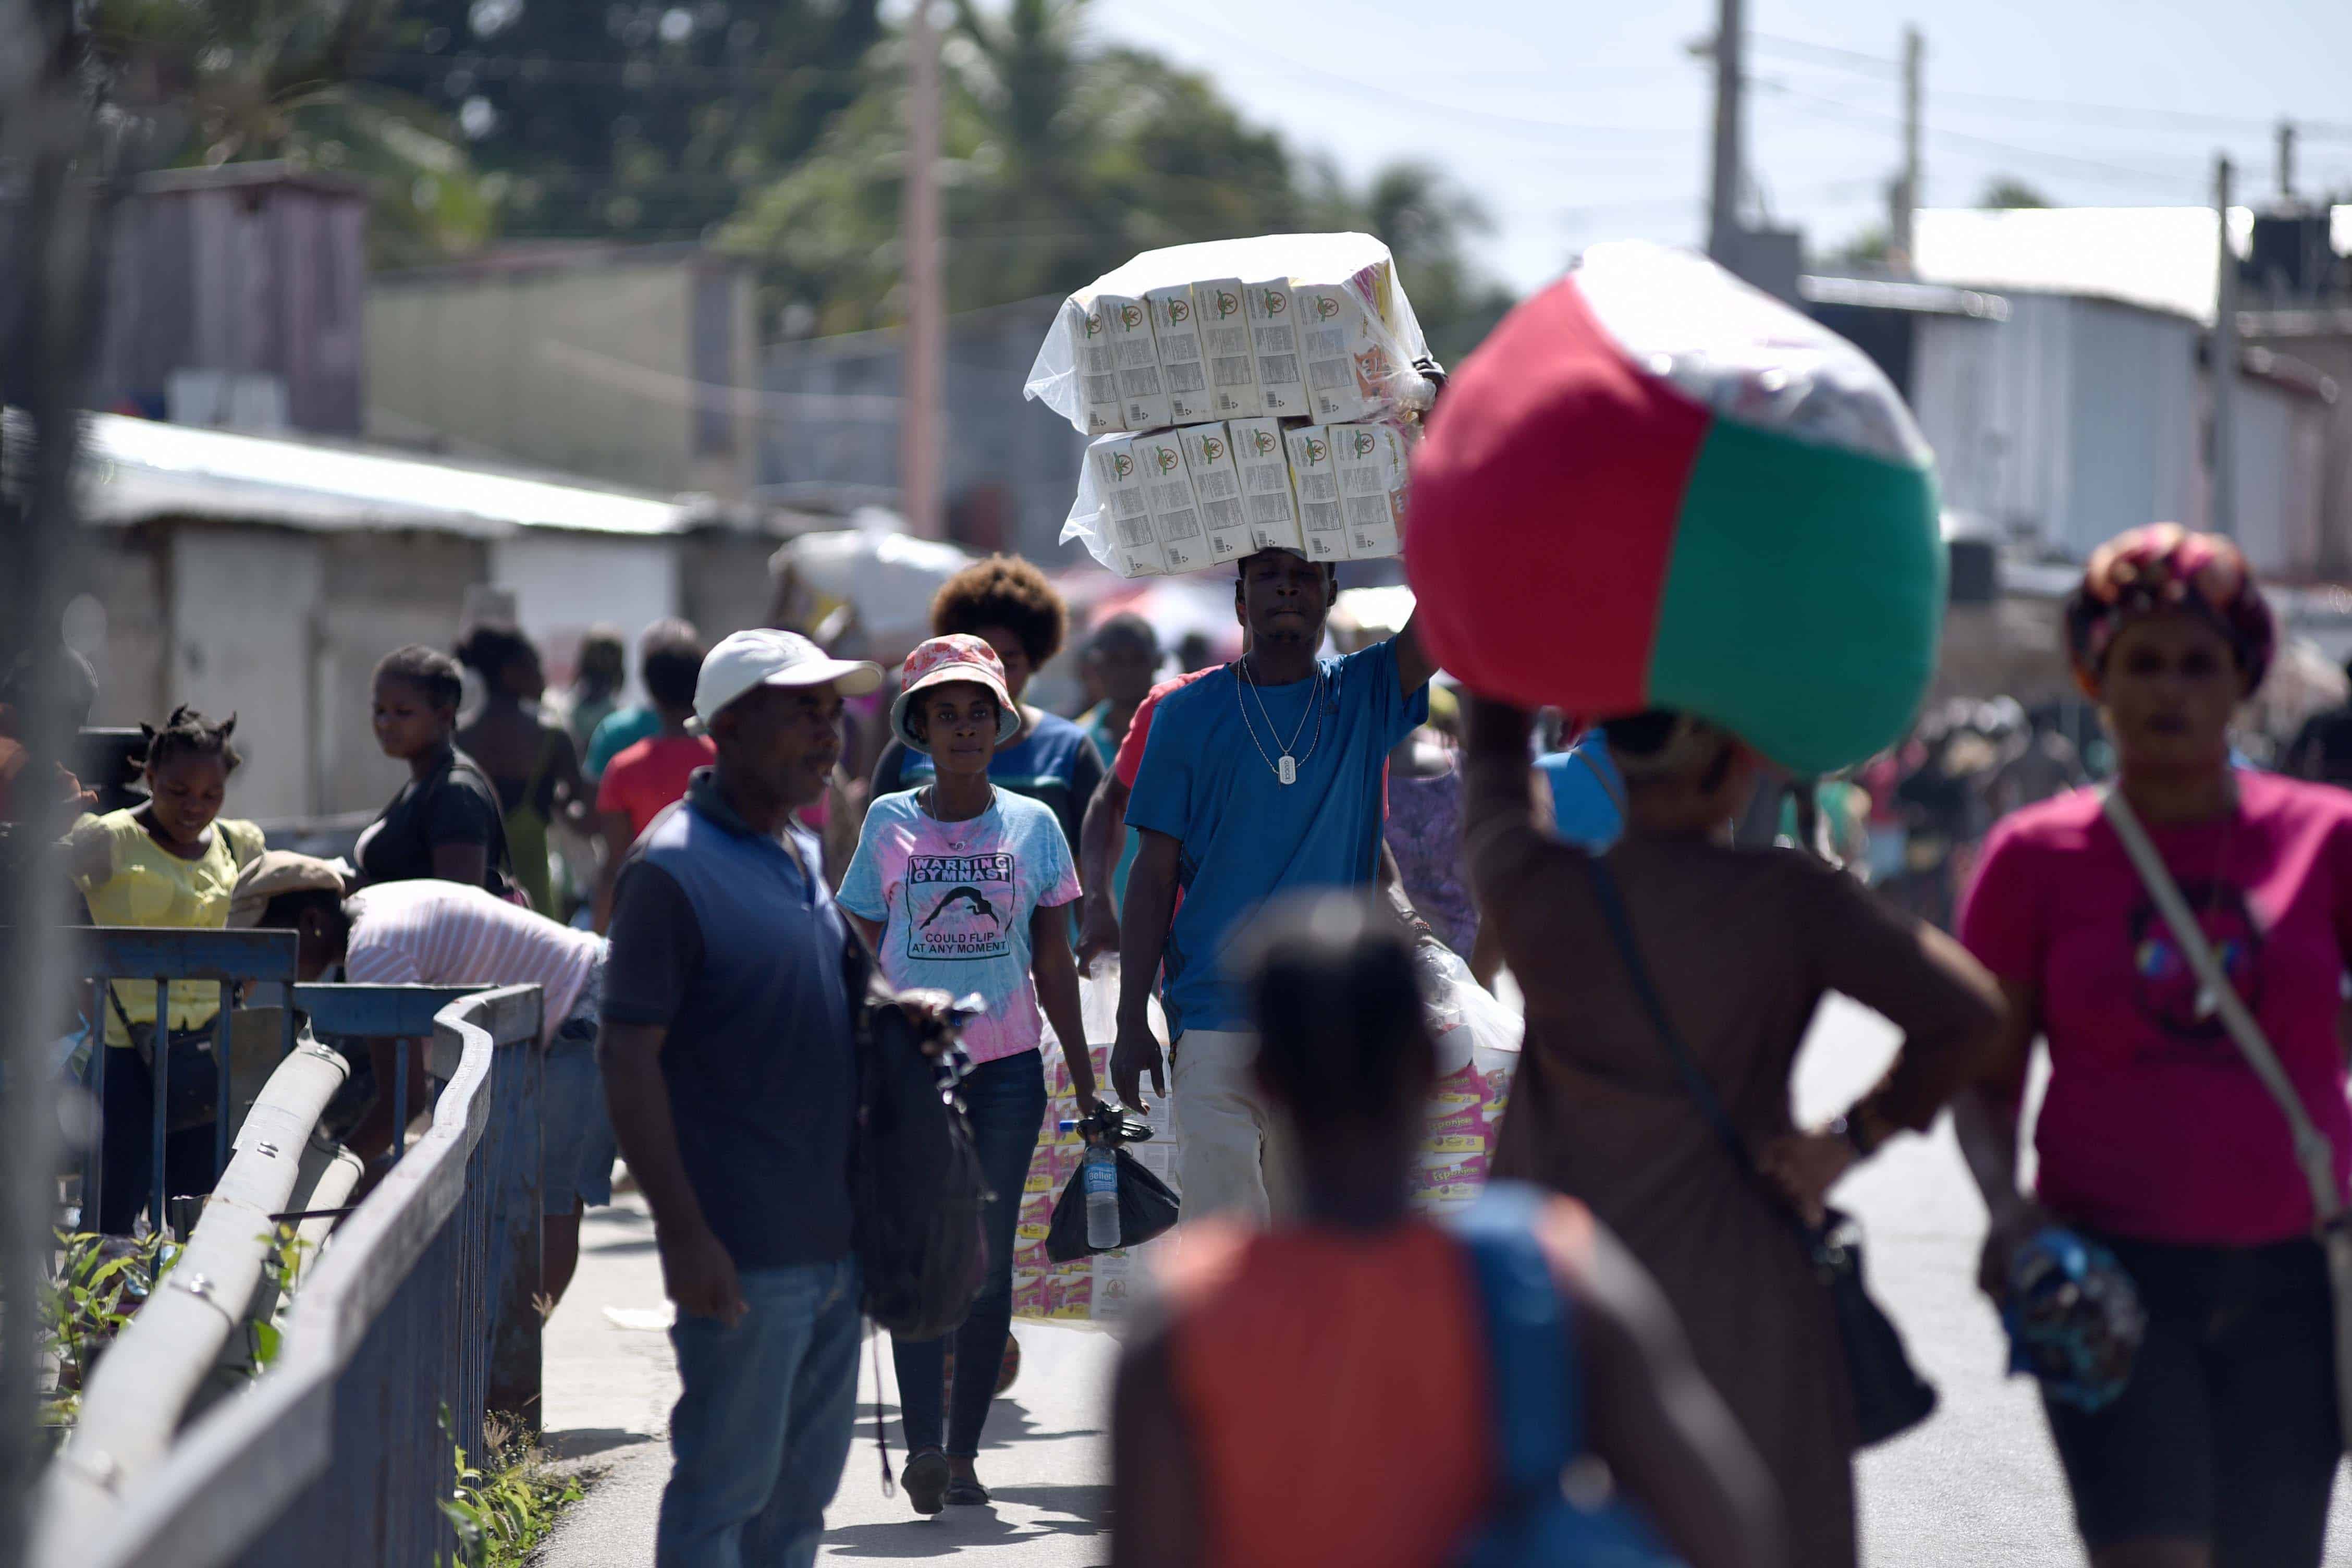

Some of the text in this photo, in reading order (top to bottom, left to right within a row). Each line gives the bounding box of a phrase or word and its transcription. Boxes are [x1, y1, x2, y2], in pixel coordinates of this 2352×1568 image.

[913, 857, 1007, 870] WARNING
[914, 868, 1008, 882] GYMNAST
[926, 932, 995, 943] COULD FLIP
[912, 941, 1006, 953] AT ANY MOMENT
